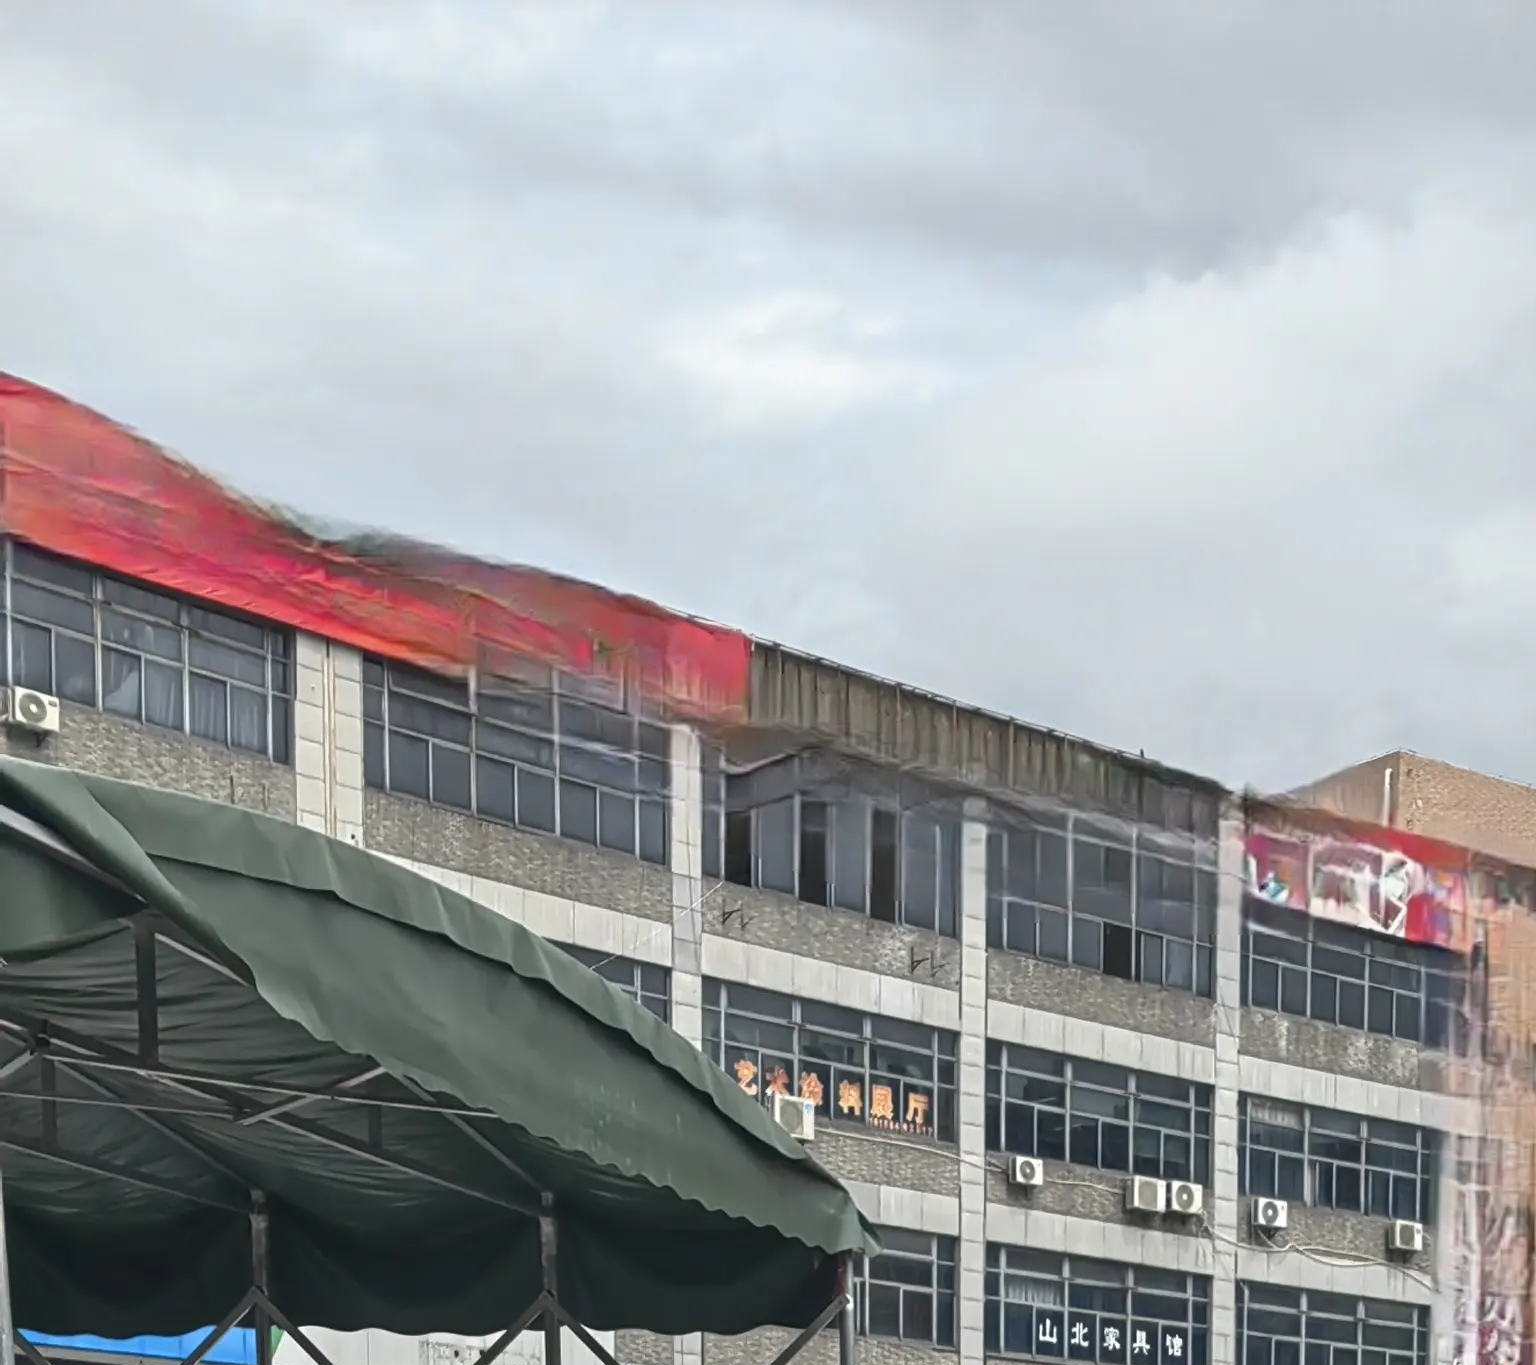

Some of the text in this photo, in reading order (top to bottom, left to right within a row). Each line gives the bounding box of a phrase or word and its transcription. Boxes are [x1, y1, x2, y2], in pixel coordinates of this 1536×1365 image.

[1038, 1317, 1184, 1357] 山北家具馆
